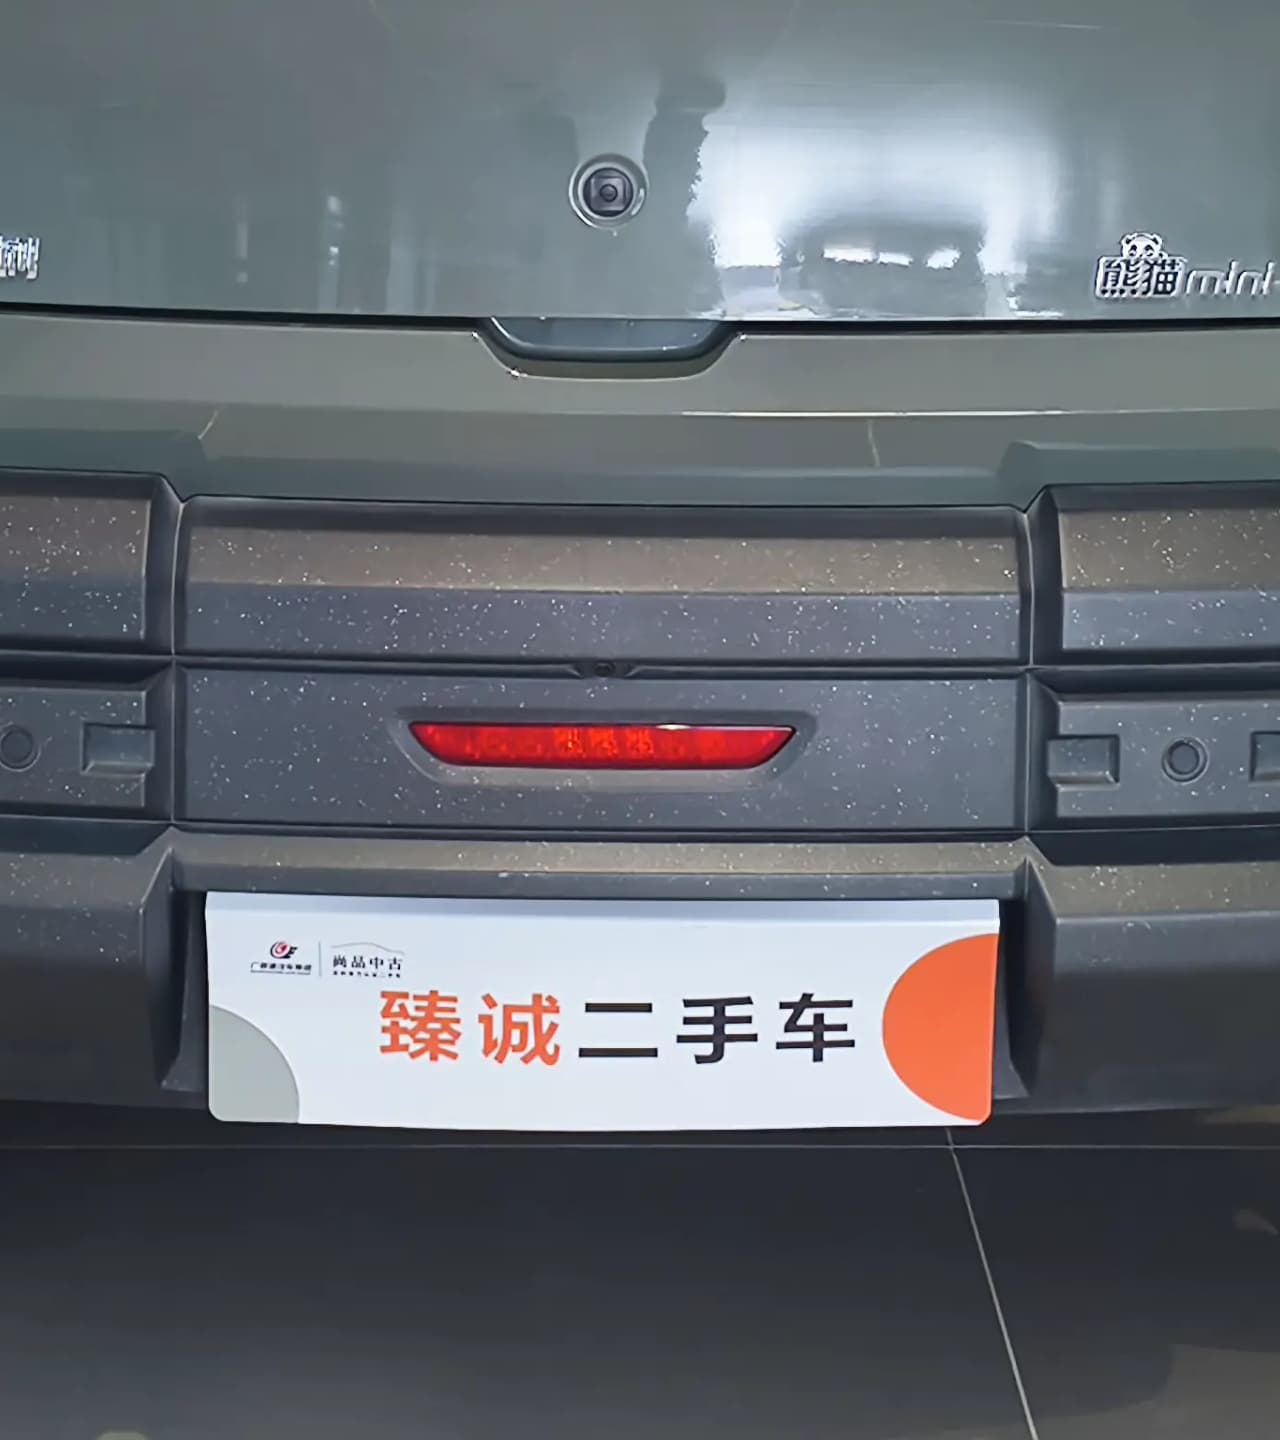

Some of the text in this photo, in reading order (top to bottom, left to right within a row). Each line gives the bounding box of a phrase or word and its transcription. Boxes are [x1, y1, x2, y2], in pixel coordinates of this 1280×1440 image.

[380, 989, 856, 1066] 臻诚二手车
